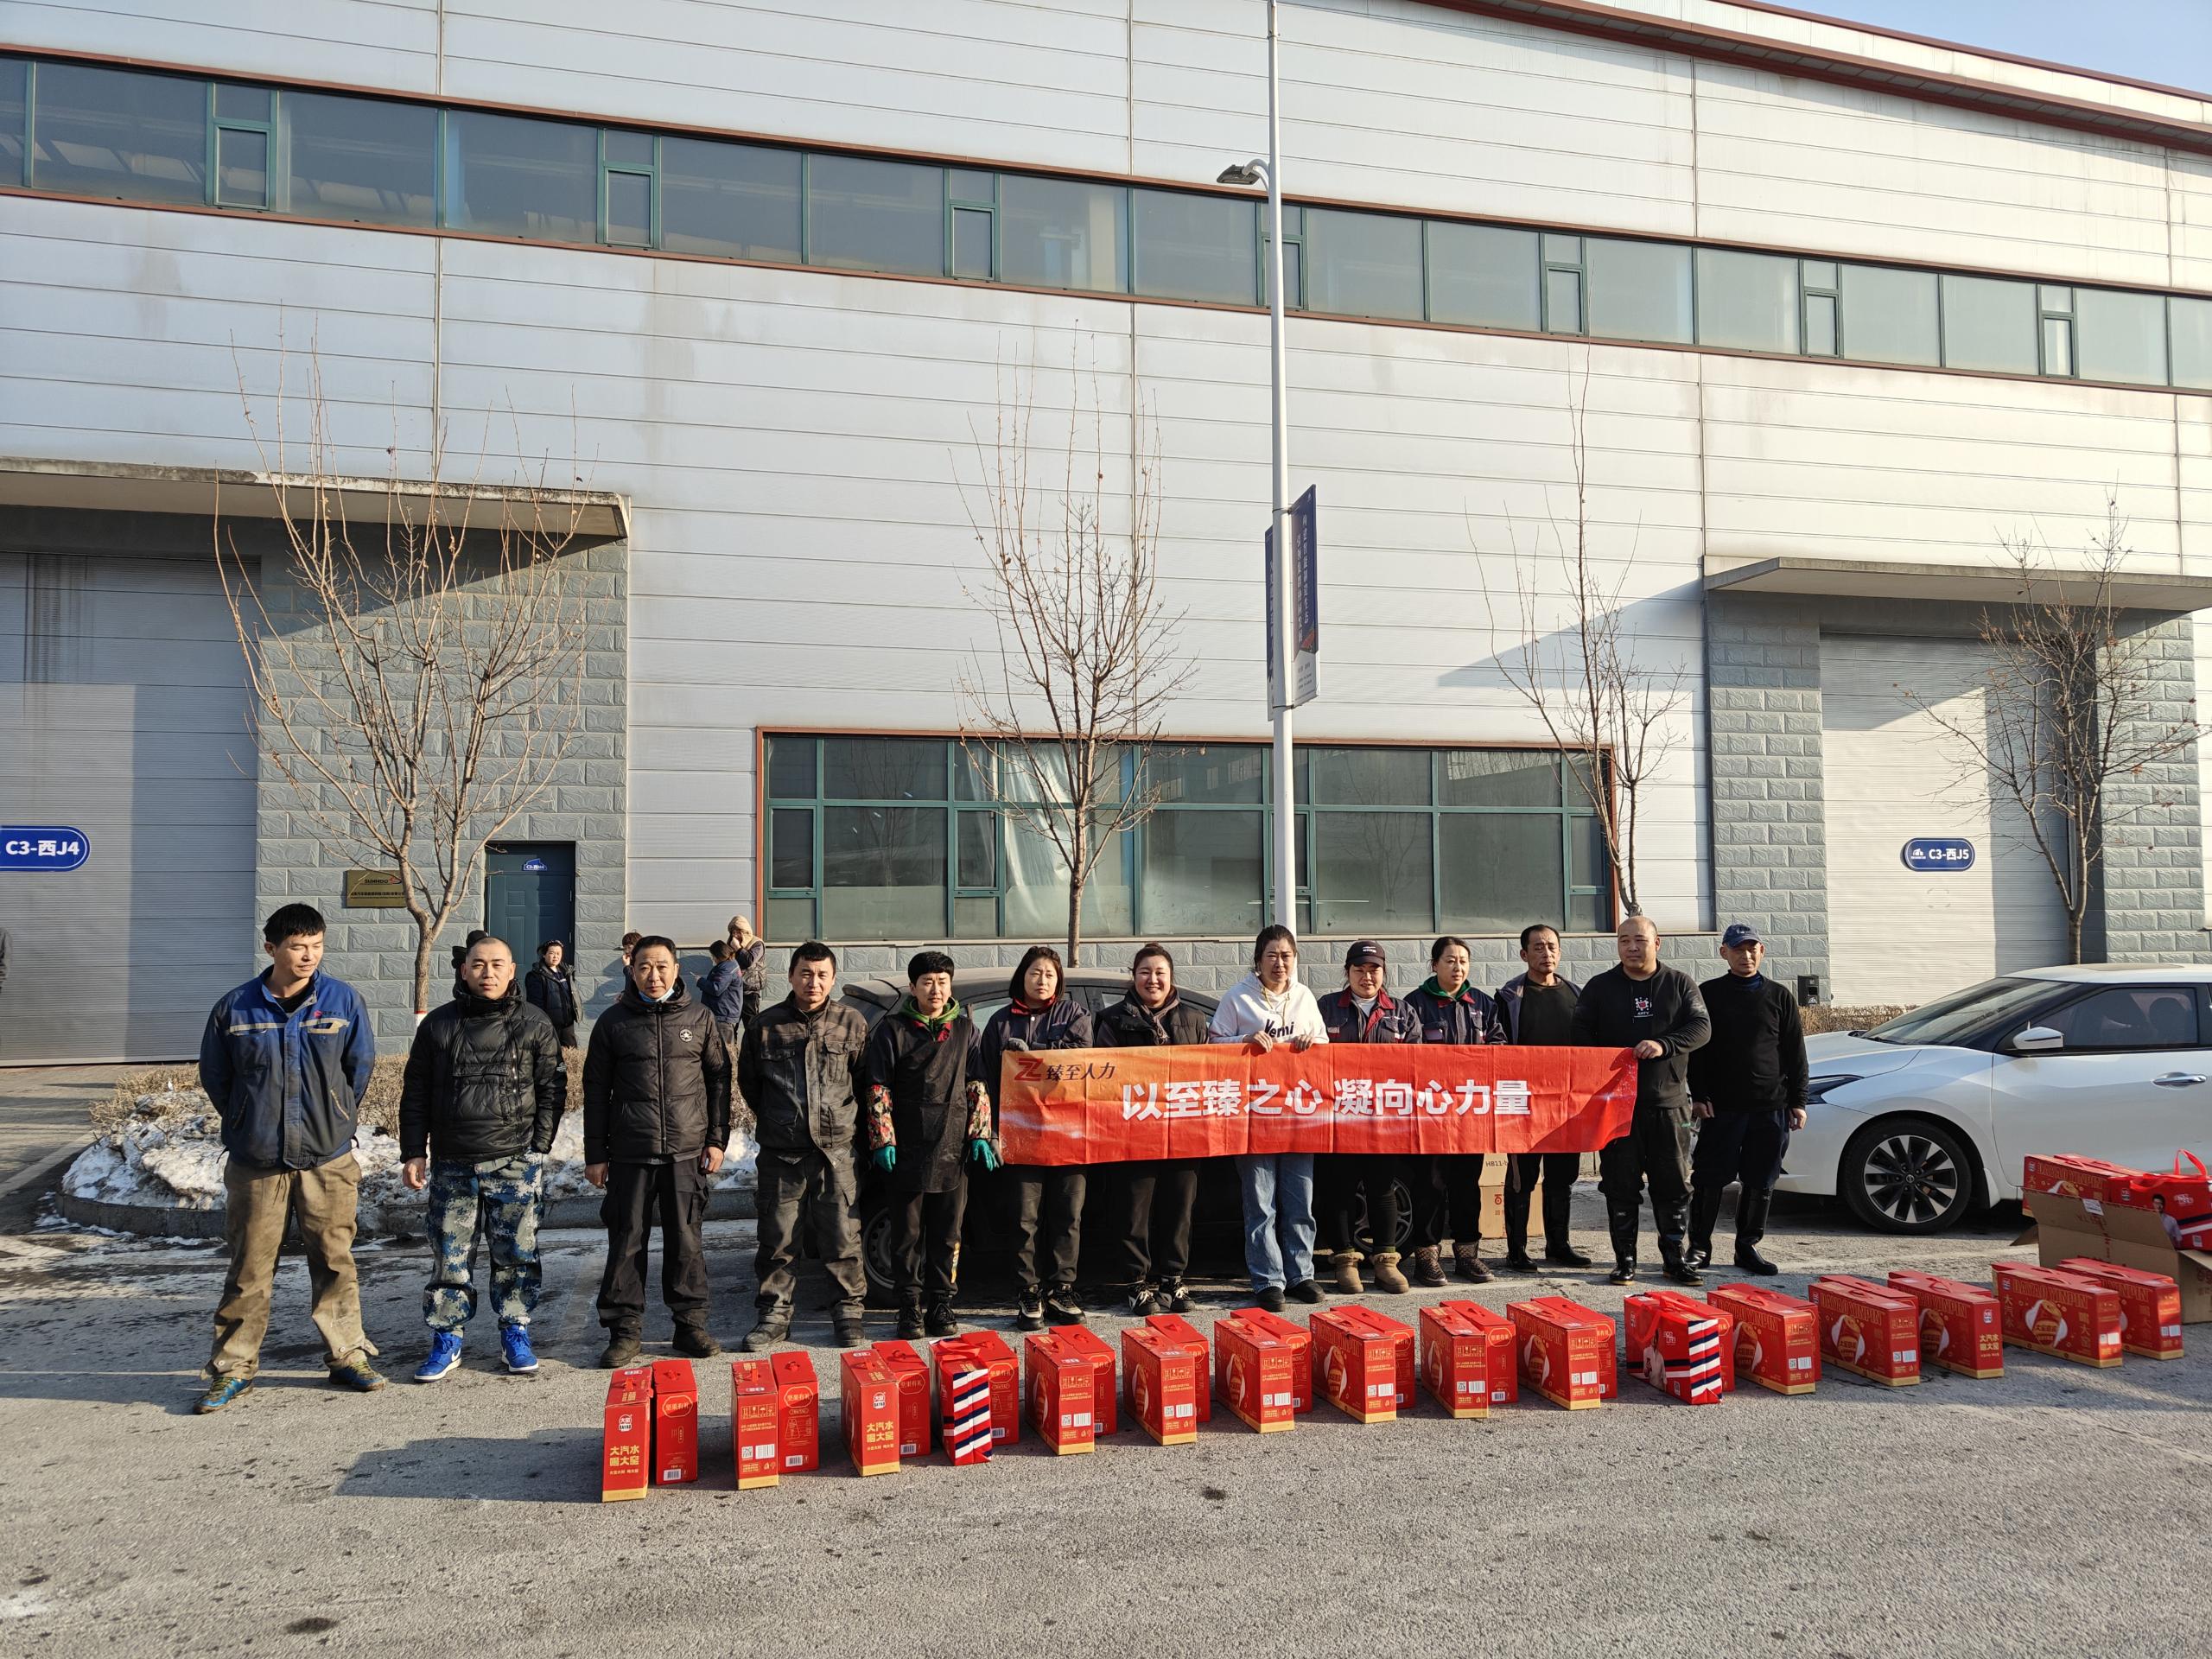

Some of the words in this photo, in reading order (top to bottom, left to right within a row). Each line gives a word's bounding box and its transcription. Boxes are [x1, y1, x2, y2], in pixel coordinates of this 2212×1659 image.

[5, 840, 80, 856] C3-西J4
[1929, 848, 1970, 861] C3-西J5
[1046, 1062, 1116, 1081] 臻至人力
[1122, 1078, 1325, 1122] 以至臻之心
[1333, 1077, 1533, 1116] 凝向心力量
[867, 1421, 894, 1433] 大汽水
[867, 1431, 894, 1443] 喝大窑
[609, 1445, 639, 1456] 大汽水
[609, 1455, 639, 1467] 喝大窑
